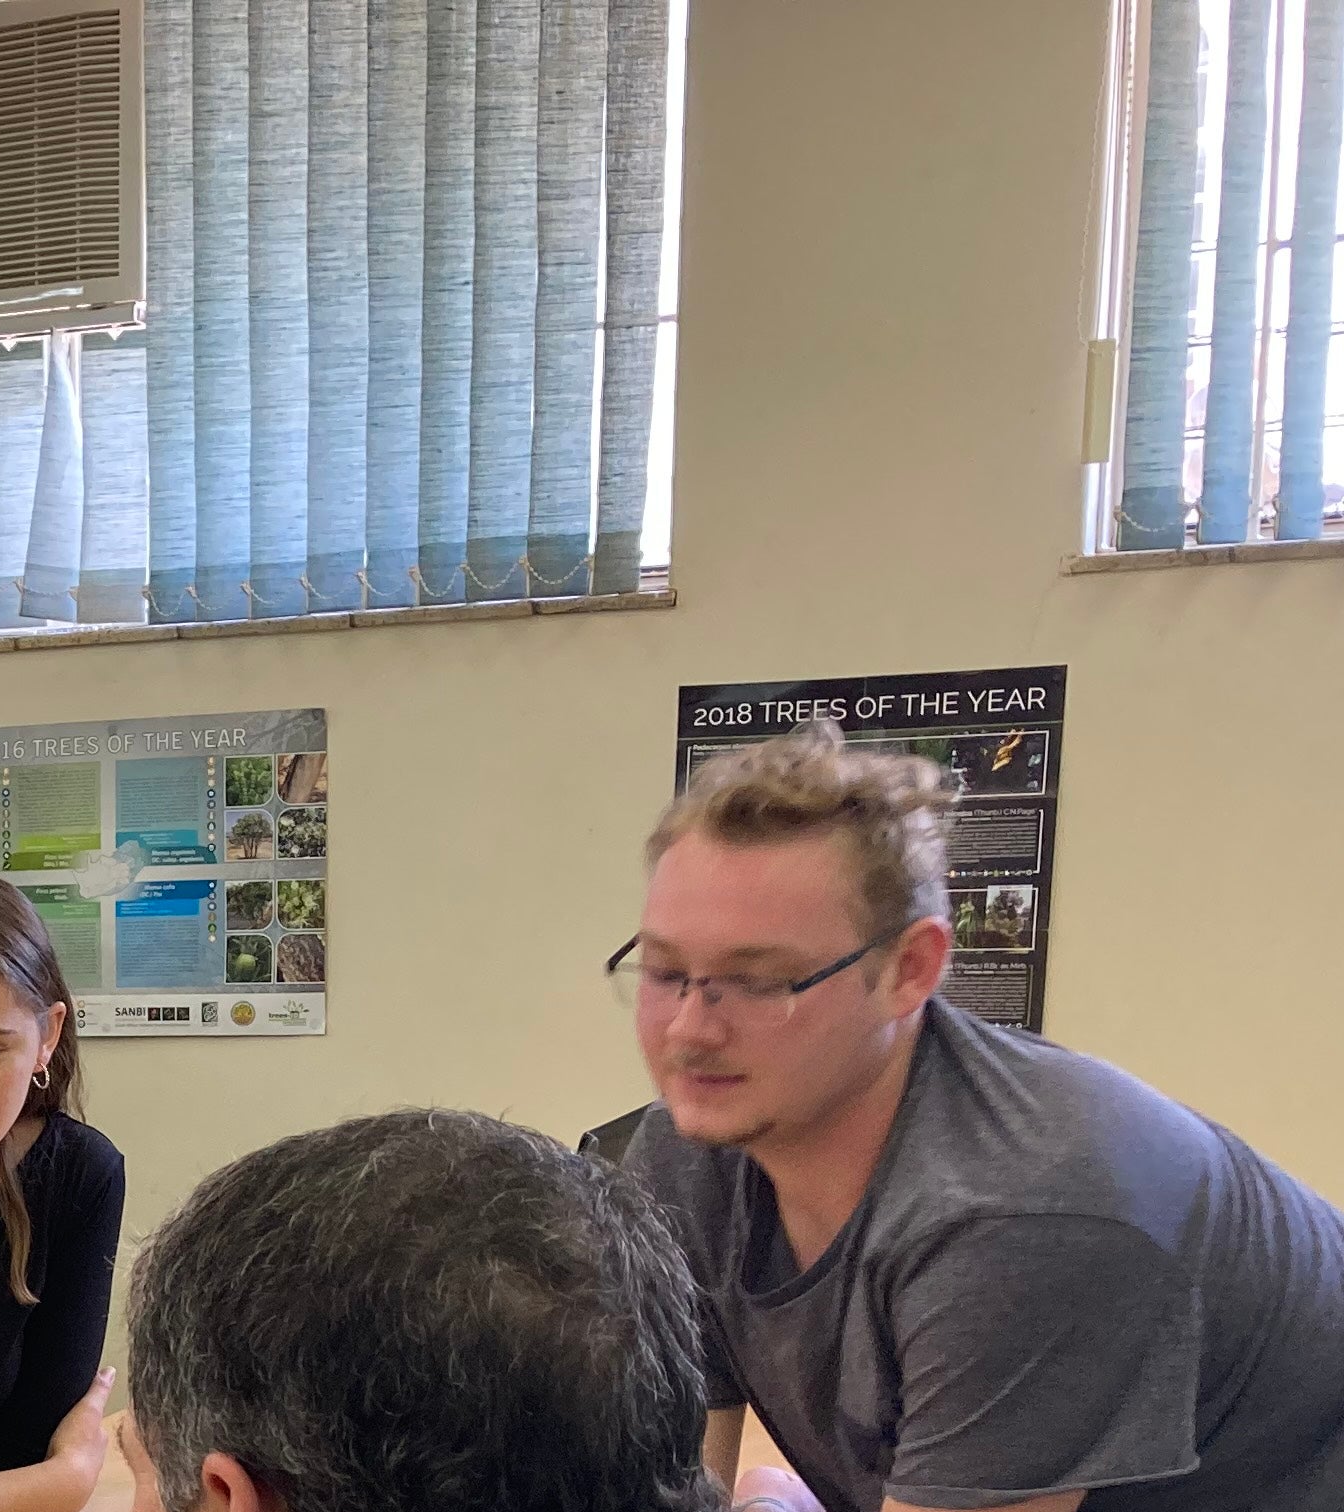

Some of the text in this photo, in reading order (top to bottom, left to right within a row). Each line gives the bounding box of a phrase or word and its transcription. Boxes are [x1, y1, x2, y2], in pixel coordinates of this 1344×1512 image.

[693, 687, 1046, 727] 2018 TREES OF THE YEAR
[33, 736, 99, 759] TREES
[107, 733, 136, 754] OF
[143, 731, 183, 751] THE
[190, 728, 247, 749] YEAR
[115, 1007, 146, 1017] SANBI
